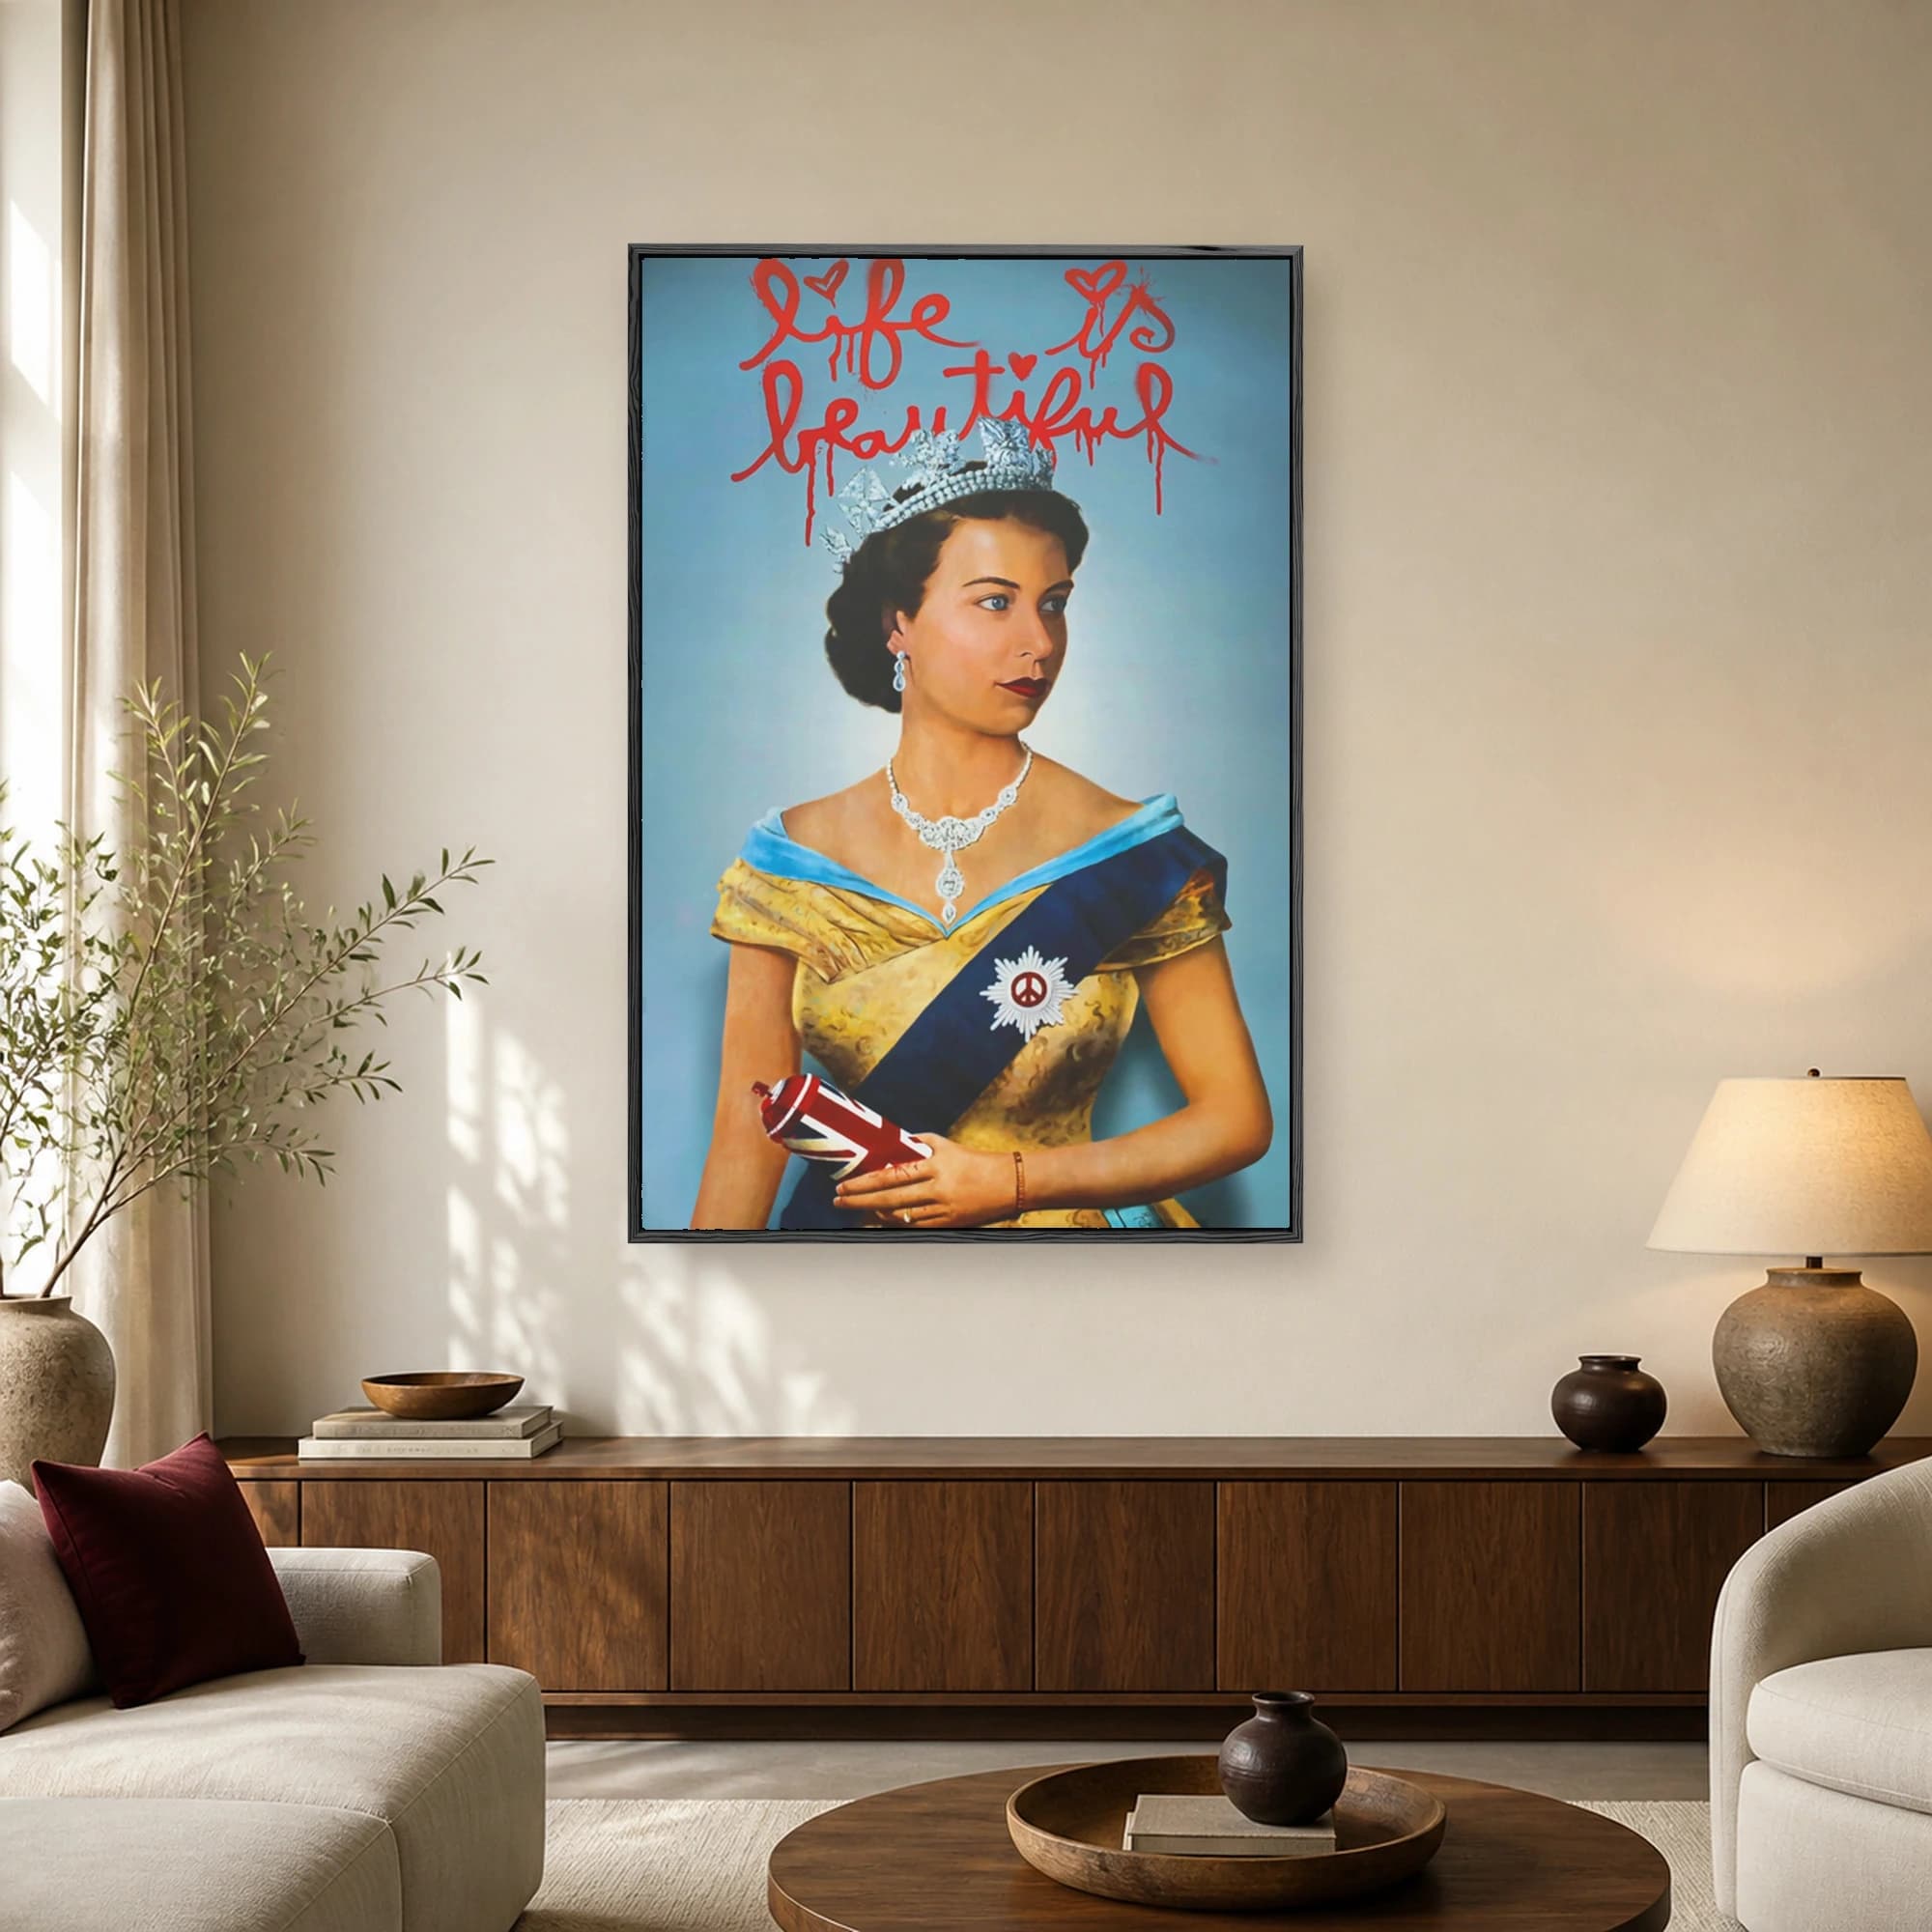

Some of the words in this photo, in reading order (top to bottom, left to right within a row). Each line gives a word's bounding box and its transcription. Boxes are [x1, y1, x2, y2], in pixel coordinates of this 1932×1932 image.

[739, 258, 980, 389] life
[1046, 261, 1176, 377] is
[730, 350, 1217, 488] beautiful
